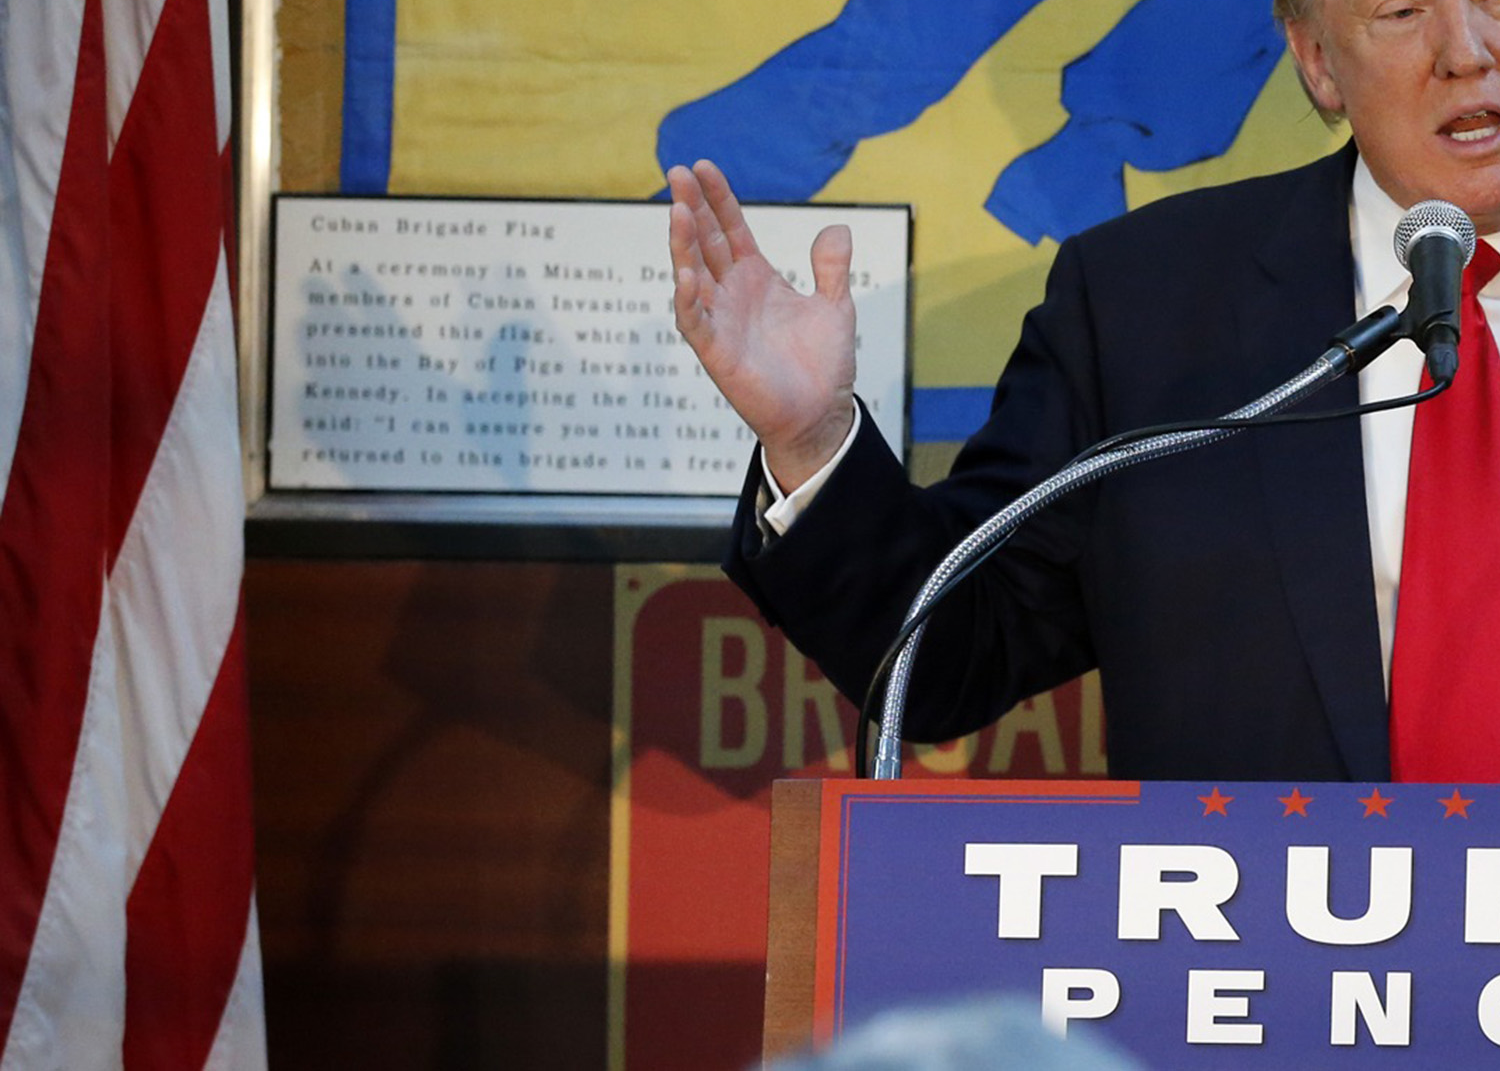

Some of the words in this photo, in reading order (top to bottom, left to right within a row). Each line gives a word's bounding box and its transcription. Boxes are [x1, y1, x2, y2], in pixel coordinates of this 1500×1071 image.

[310, 215, 380, 234] Cuban
[396, 217, 488, 238] Brigade
[505, 220, 556, 240] Flag
[308, 259, 334, 274] At
[350, 263, 360, 274] a
[376, 262, 488, 280] ceremony
[506, 262, 527, 279] in
[544, 265, 623, 284] Miami,
[308, 289, 414, 307] members
[430, 293, 450, 308] of
[467, 293, 536, 311] Cuban
[552, 295, 650, 314] Invasion
[306, 323, 424, 340] presented
[438, 325, 484, 341] this
[575, 327, 640, 345] which
[305, 353, 351, 369] into
[366, 353, 401, 369] the
[418, 355, 459, 376] Bay
[474, 357, 496, 373] of
[513, 357, 564, 375] Pigs
[580, 358, 679, 376] Invasion
[304, 384, 410, 404] Kennedy.
[426, 386, 448, 403] In
[463, 390, 576, 409] accepting
[592, 392, 628, 407] the
[642, 392, 697, 411] flag,
[410, 419, 450, 435] can
[465, 422, 544, 436] assure
[561, 425, 599, 441] you
[614, 424, 661, 439] that
[676, 425, 721, 441] this
[302, 449, 406, 465] returned
[420, 450, 443, 465] to
[458, 451, 503, 467] this
[518, 452, 608, 469] brigade
[625, 454, 646, 470] in
[661, 458, 672, 470] a
[688, 455, 736, 471] free
